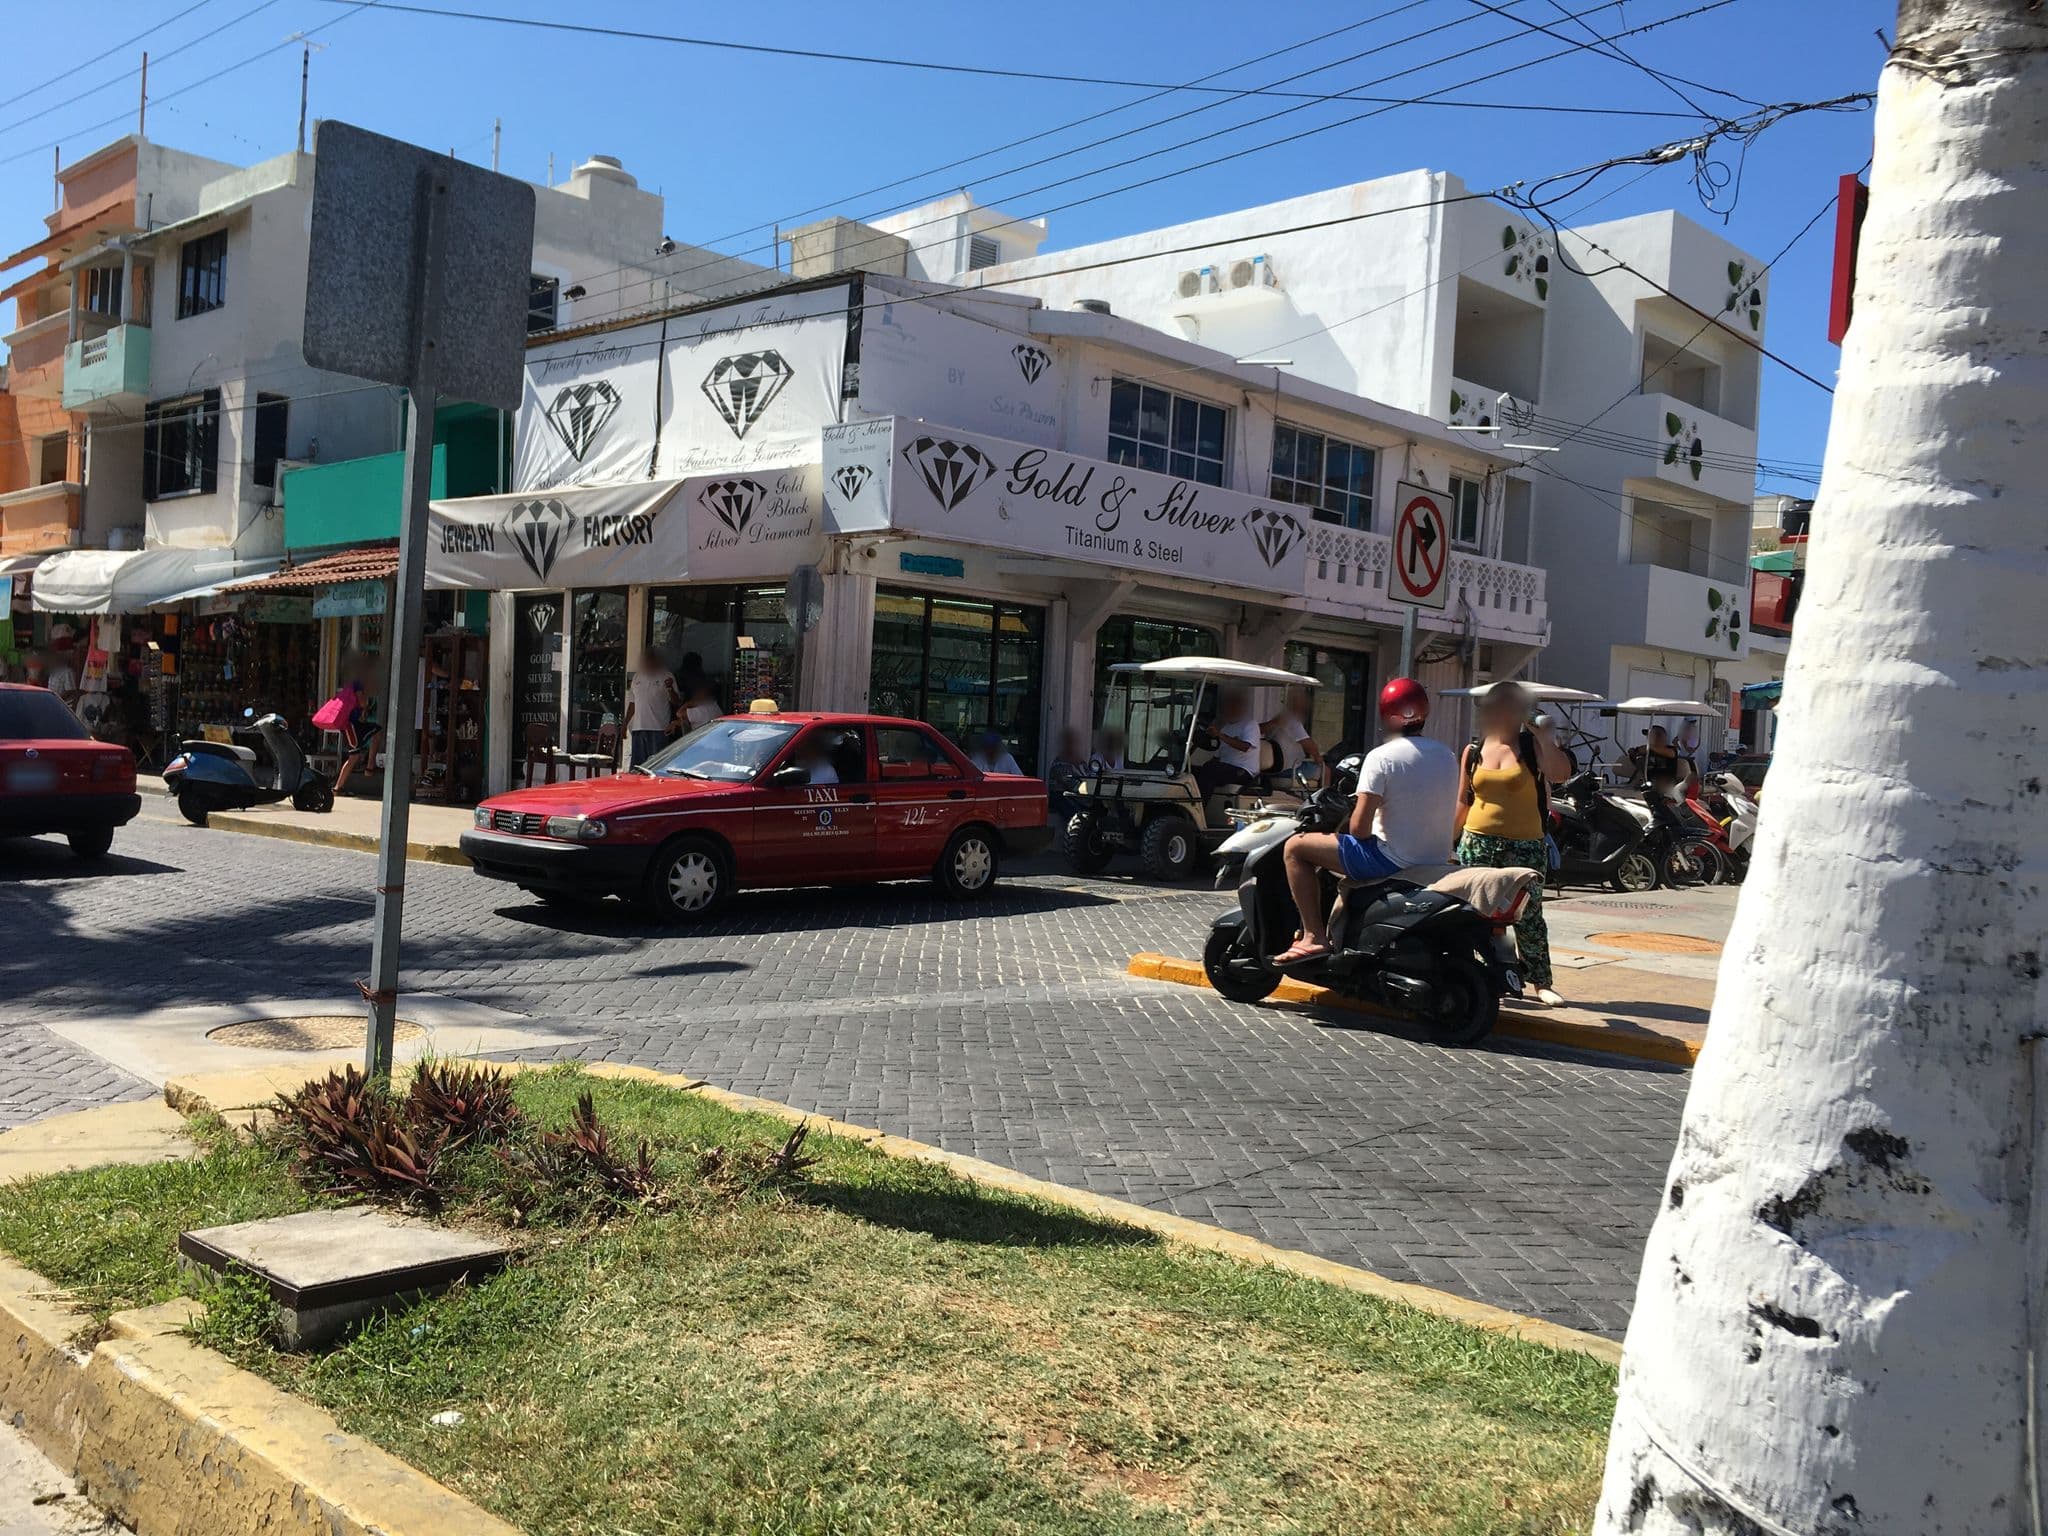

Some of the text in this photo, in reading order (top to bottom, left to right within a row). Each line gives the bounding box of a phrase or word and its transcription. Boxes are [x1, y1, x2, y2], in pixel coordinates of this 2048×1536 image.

[586, 339, 633, 367] Factory
[823, 426, 848, 442] Gold
[775, 474, 805, 495] Gold
[1005, 449, 1236, 535] Gold & Silver
[766, 497, 810, 519] Black
[440, 512, 658, 554] JEWELRY FACTORY
[698, 518, 814, 551] Silver Diamond
[1065, 525, 1184, 564] Titanium & Steel
[530, 653, 552, 665] GOLD
[527, 673, 553, 684] SILVER
[532, 692, 553, 703] STEEL
[521, 712, 558, 723] TITANIUM
[804, 788, 839, 802] TAXI
